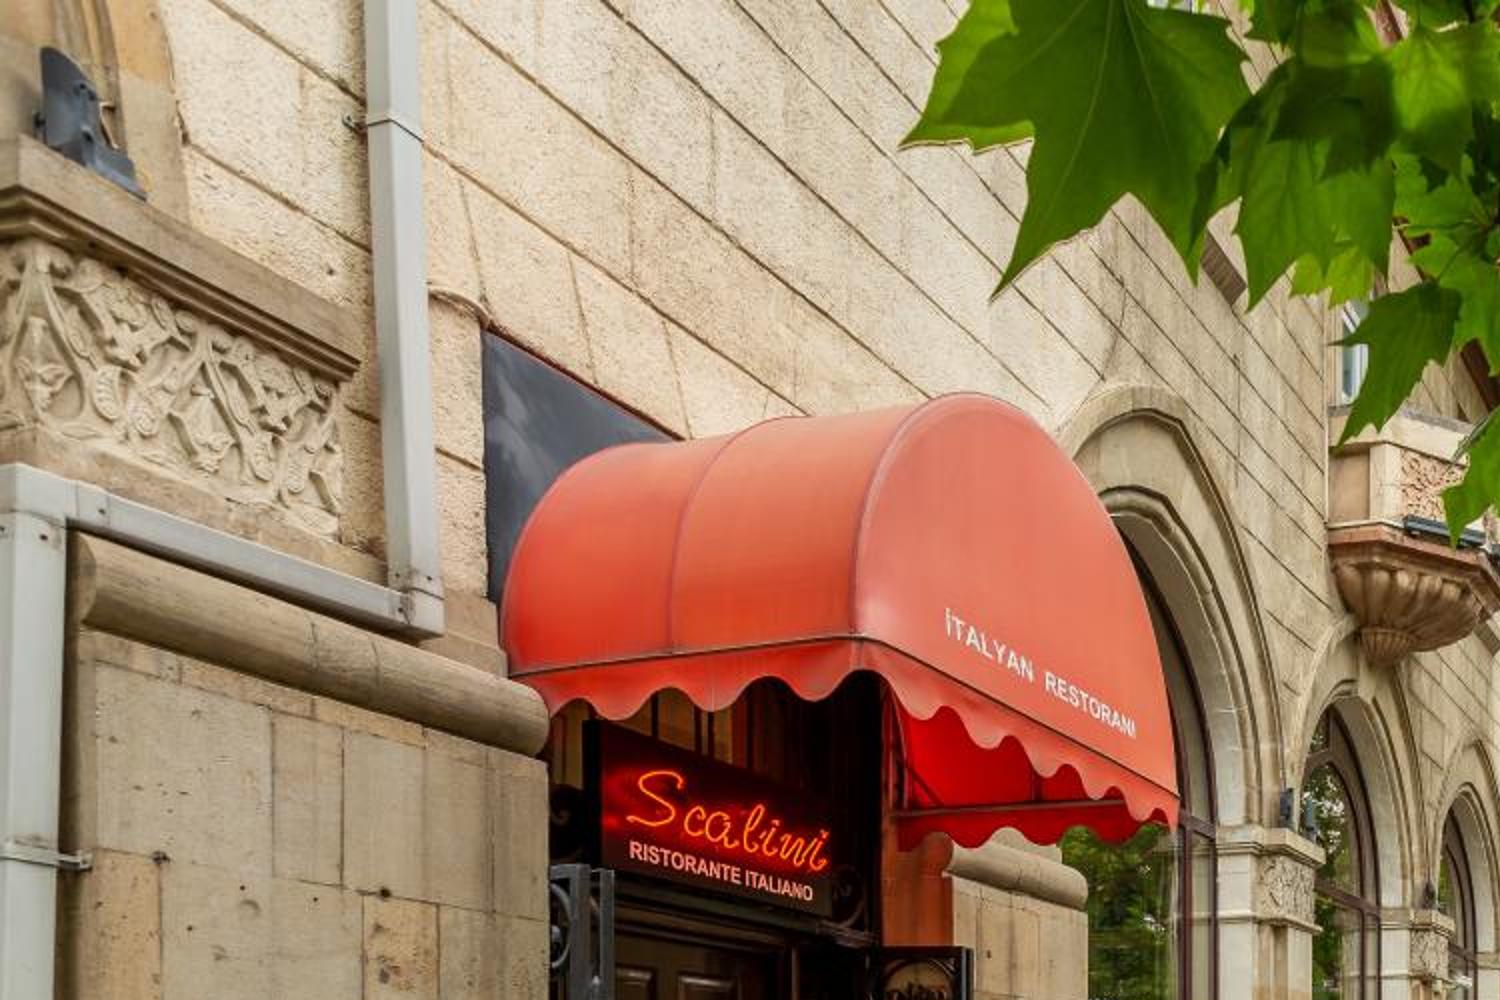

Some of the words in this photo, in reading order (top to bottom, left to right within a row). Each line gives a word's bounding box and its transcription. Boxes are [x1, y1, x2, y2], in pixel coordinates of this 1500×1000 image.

[1044, 671, 1137, 740] RESTORANI
[625, 769, 831, 872] Scalini
[629, 841, 742, 885] RISTORANTE
[745, 870, 814, 901] ITALIANO
